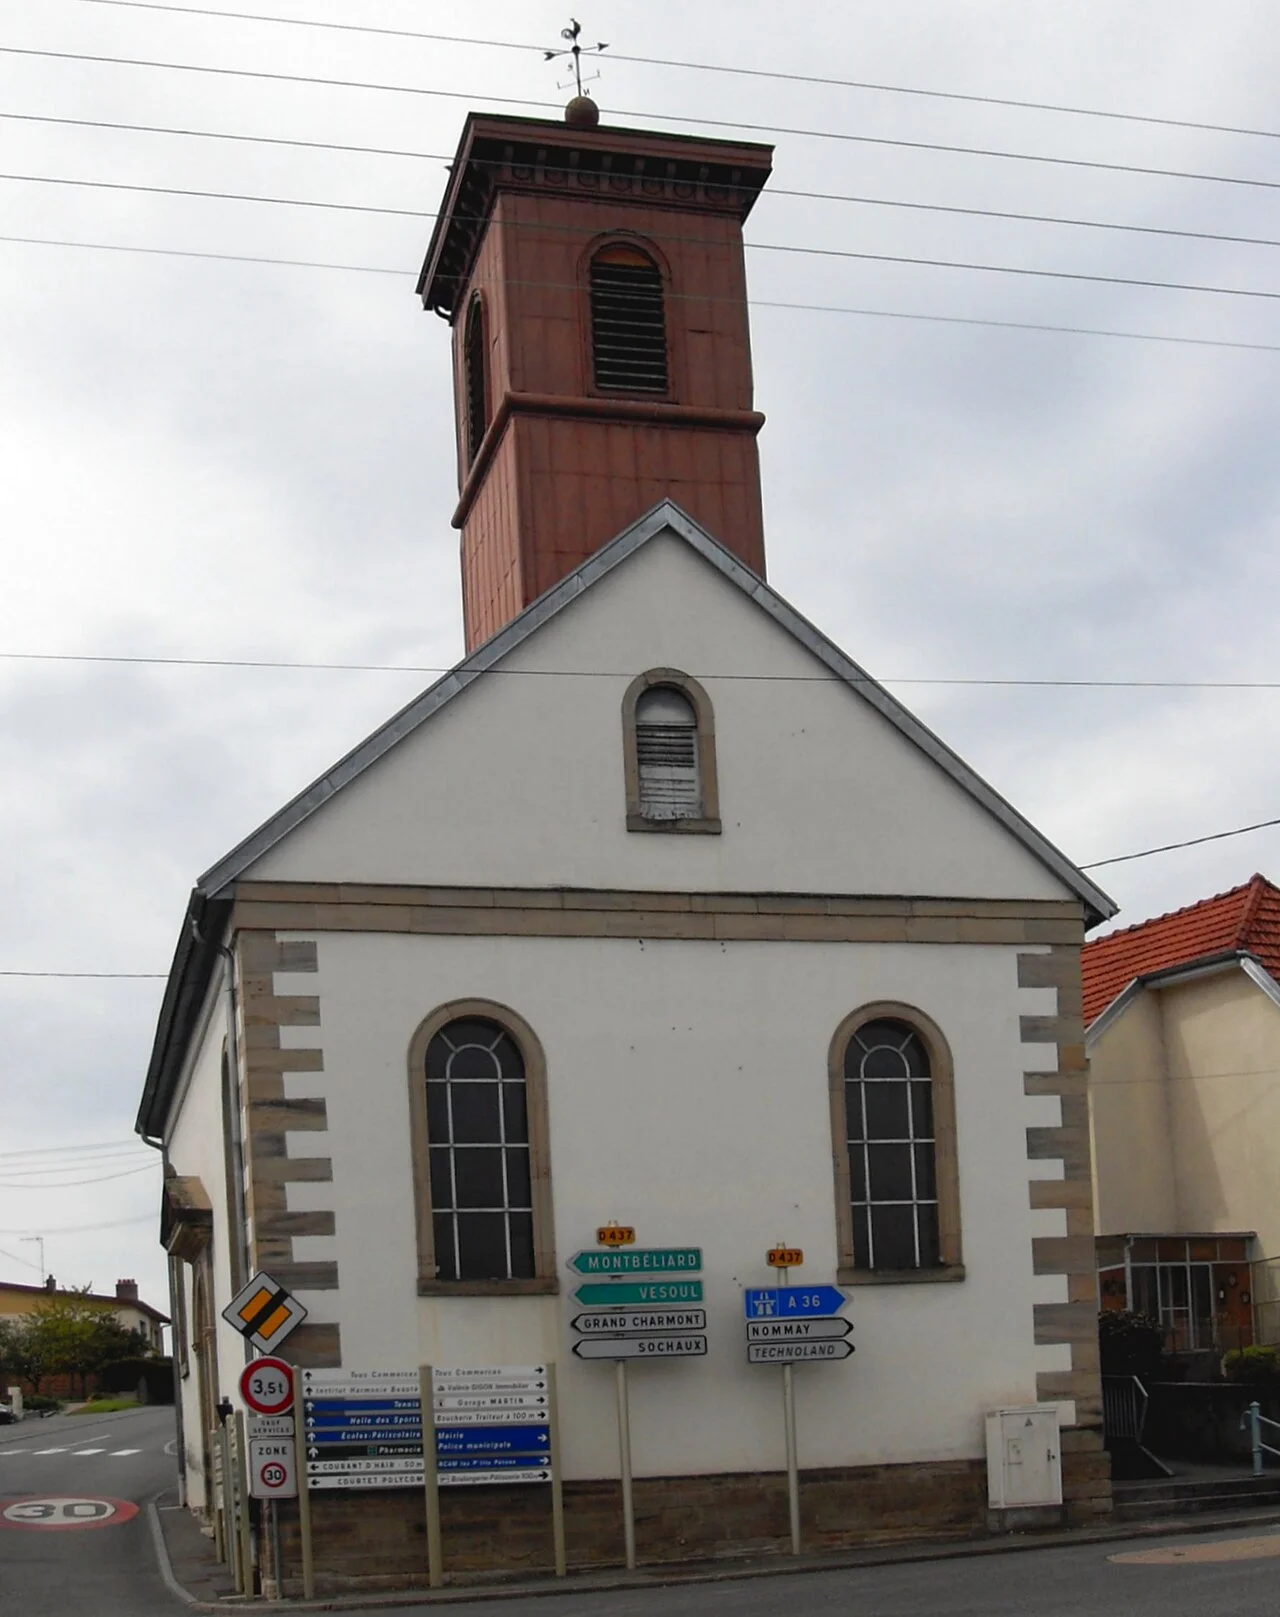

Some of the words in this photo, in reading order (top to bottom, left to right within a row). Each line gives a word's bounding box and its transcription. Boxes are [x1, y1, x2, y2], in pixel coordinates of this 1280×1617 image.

[599, 1232, 605, 1241] D
[609, 1230, 632, 1240] 437
[588, 1254, 696, 1269] MONTBÉLIARD
[769, 1253, 775, 1262] D
[779, 1252, 801, 1262] 437
[639, 1286, 698, 1299] VESOUL
[789, 1296, 796, 1308] A
[802, 1295, 821, 1307] 36
[584, 1318, 626, 1329] GRAND
[632, 1315, 700, 1327] CHARMONT
[752, 1325, 810, 1336] NOMMAY
[638, 1340, 701, 1352] SOCHAUX
[754, 1345, 835, 1358] TECHNOLAND
[457, 1399, 486, 1407] Garage
[394, 1416, 420, 1424] Sports
[258, 1446, 287, 1455] ZONE
[379, 1446, 421, 1454] Pharmacie
[438, 1442, 463, 1450] Police
[266, 1470, 282, 1481] 30
[12, 1503, 108, 1518] 30
